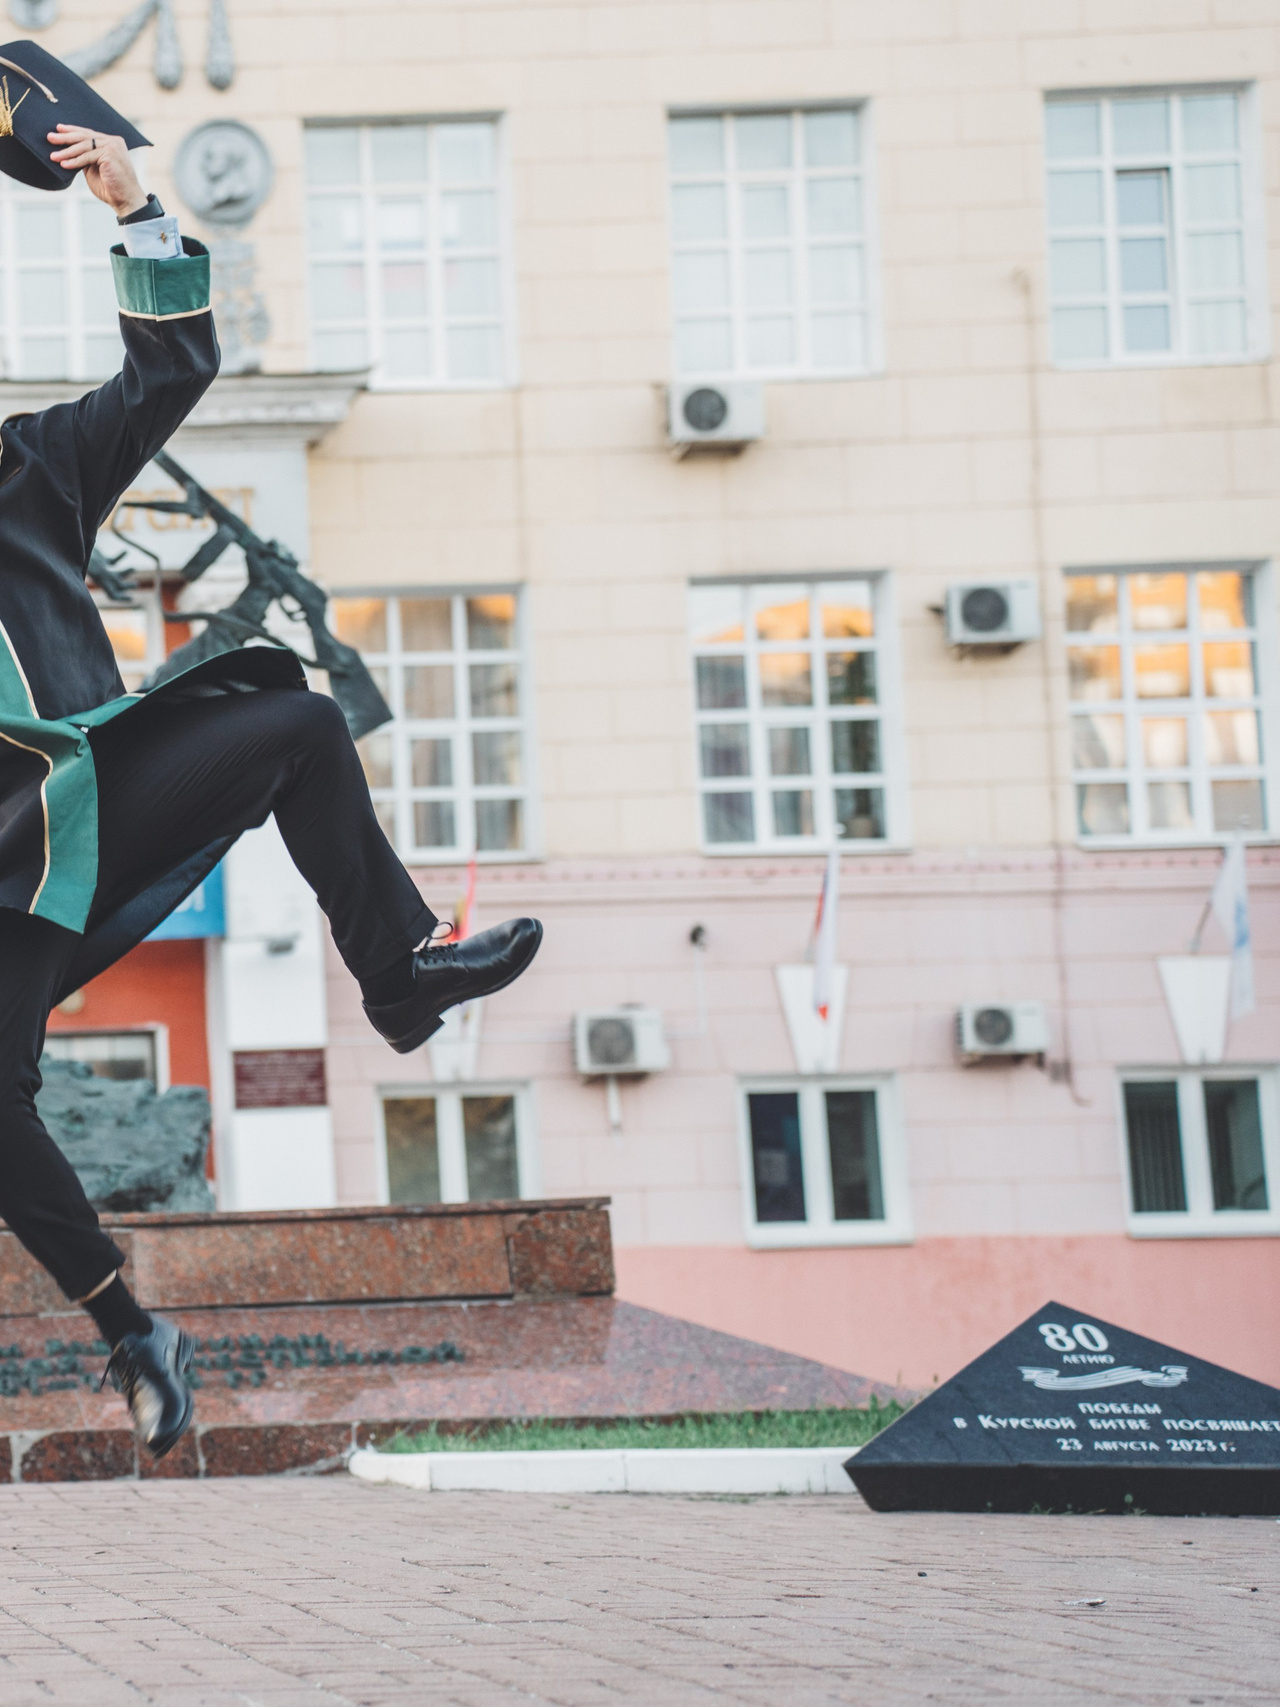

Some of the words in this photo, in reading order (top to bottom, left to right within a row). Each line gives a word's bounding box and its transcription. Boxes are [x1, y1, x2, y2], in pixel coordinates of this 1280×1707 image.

[1038, 1323, 1109, 1351] 80
[1062, 1354, 1115, 1364] ЛЕТИЮ
[1078, 1402, 1162, 1415] ПОБЕДЫ
[1088, 1418, 1151, 1431] БИТВЕ
[1056, 1437, 1083, 1451] 23
[1093, 1440, 1160, 1451] АВГУСТА
[1166, 1438, 1218, 1452] 2023
